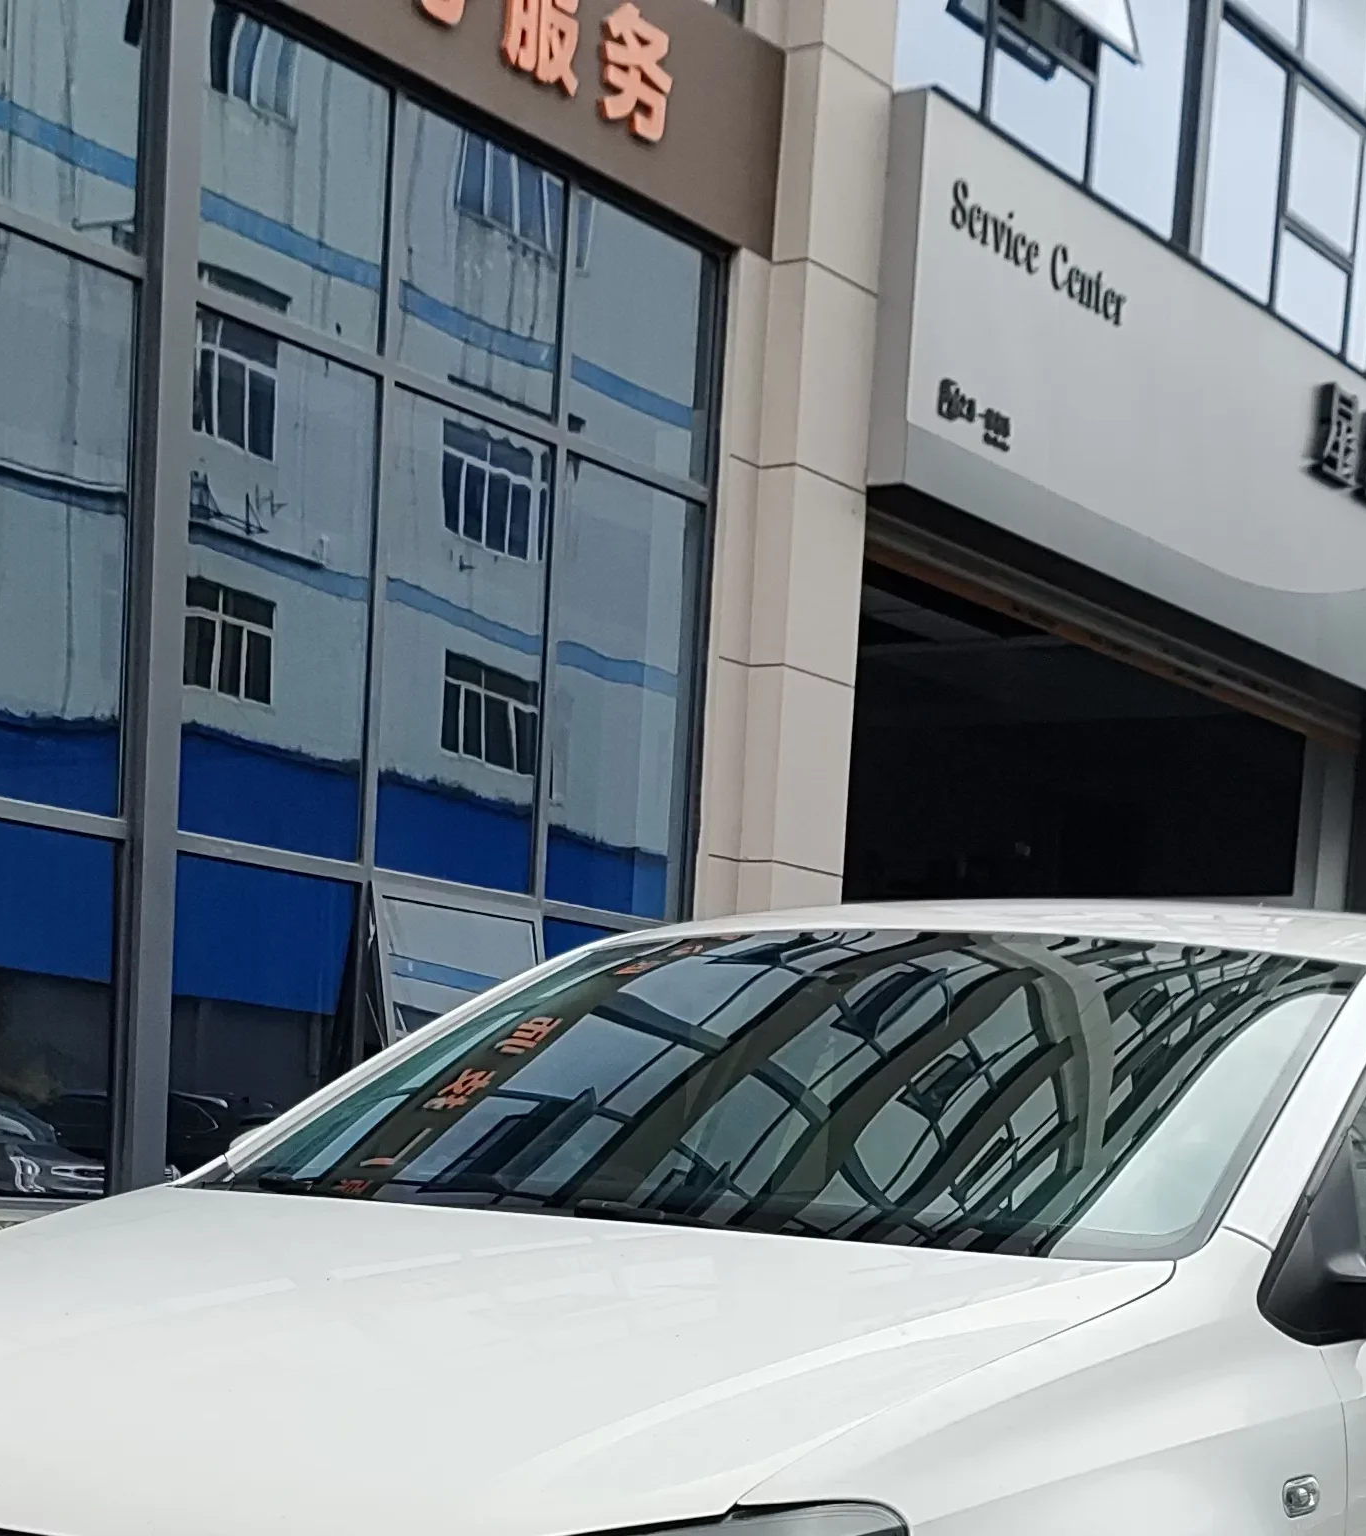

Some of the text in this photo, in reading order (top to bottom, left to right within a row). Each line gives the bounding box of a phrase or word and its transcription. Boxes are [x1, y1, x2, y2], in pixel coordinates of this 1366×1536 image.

[420, 0, 672, 143] 服务
[950, 178, 1127, 327] Service Center
